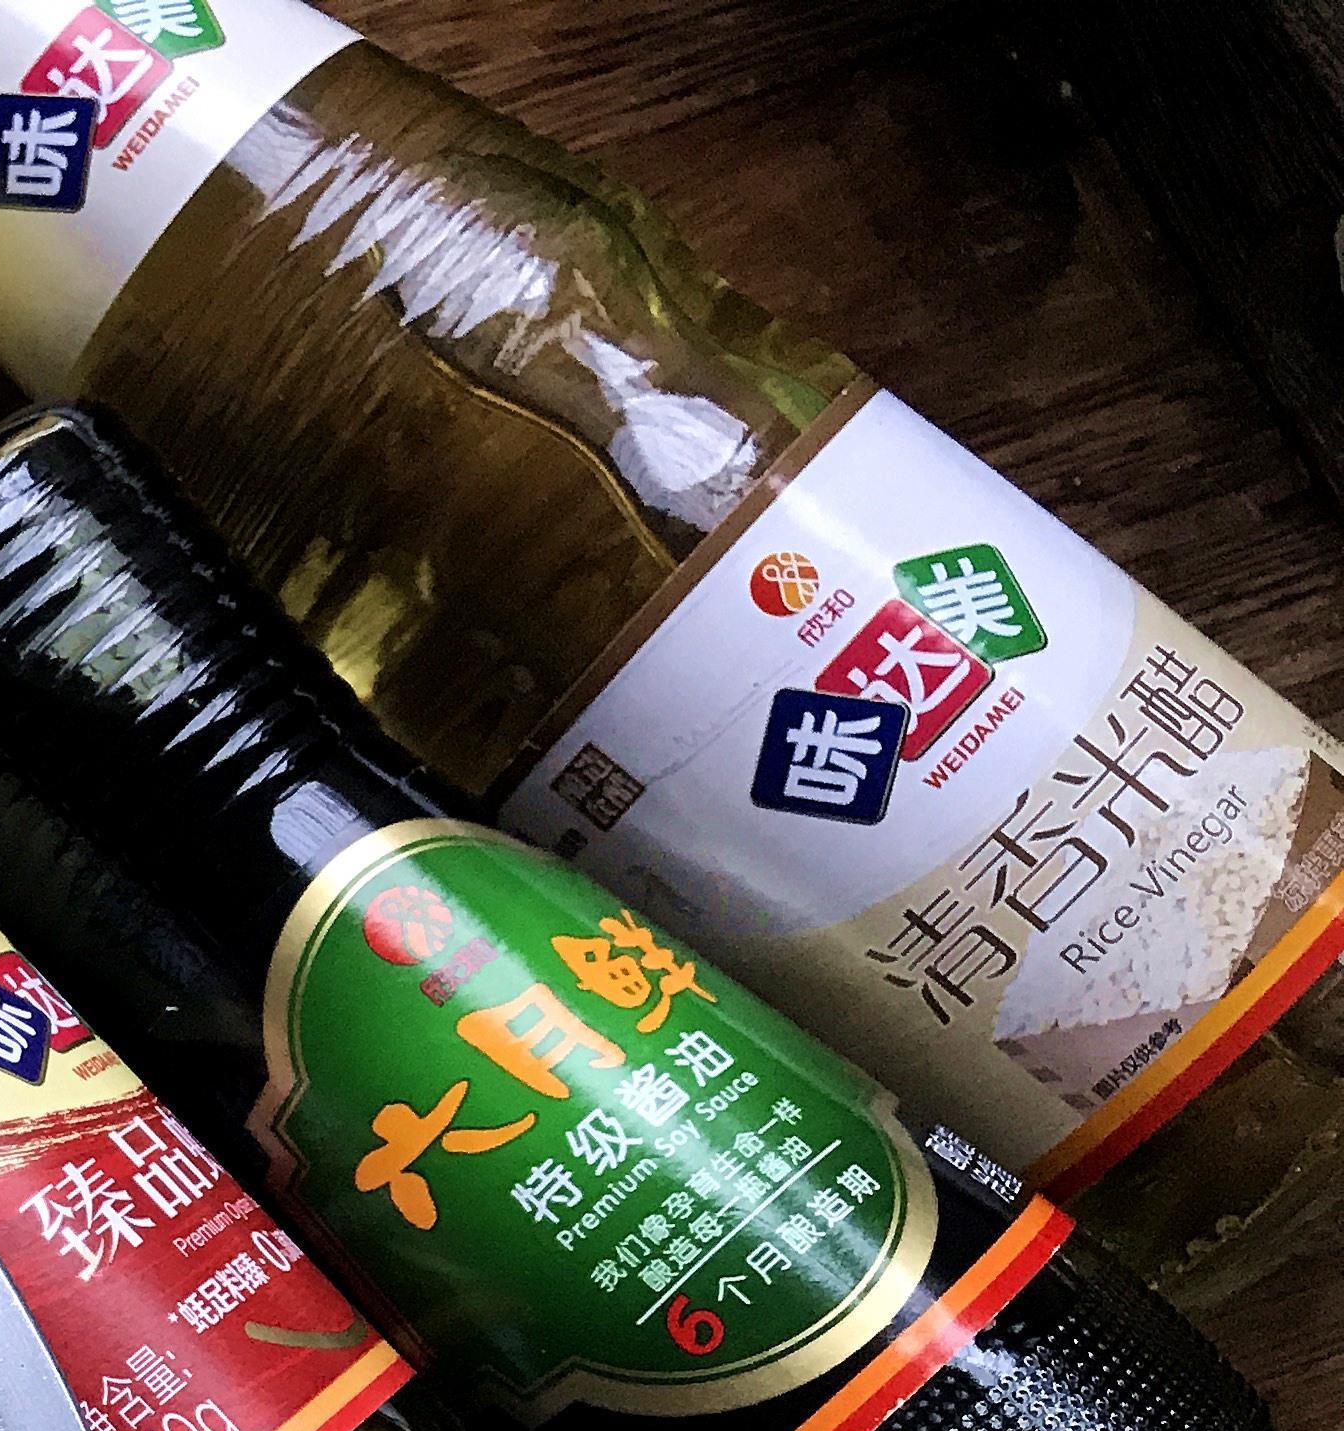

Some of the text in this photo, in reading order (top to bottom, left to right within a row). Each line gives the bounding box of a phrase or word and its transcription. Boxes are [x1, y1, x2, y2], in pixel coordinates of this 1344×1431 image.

[112, 76, 200, 172] WEIDAMEI
[784, 557, 1022, 806] 味达美
[797, 589, 856, 648] 欣和
[923, 687, 1026, 789] WEIDAMEI
[865, 645, 1244, 1025] 清香米醋
[1059, 783, 1249, 974] Rice Vinegar
[355, 909, 717, 1230] 六月鲜
[511, 1031, 736, 1223] 特级酱油
[556, 1071, 759, 1252] Premium Soy Sauce
[173, 1209, 235, 1257] Premium
[590, 1096, 804, 1293] 我们像孕育生命一样
[638, 1136, 813, 1293] 酿造每一瓶酱油
